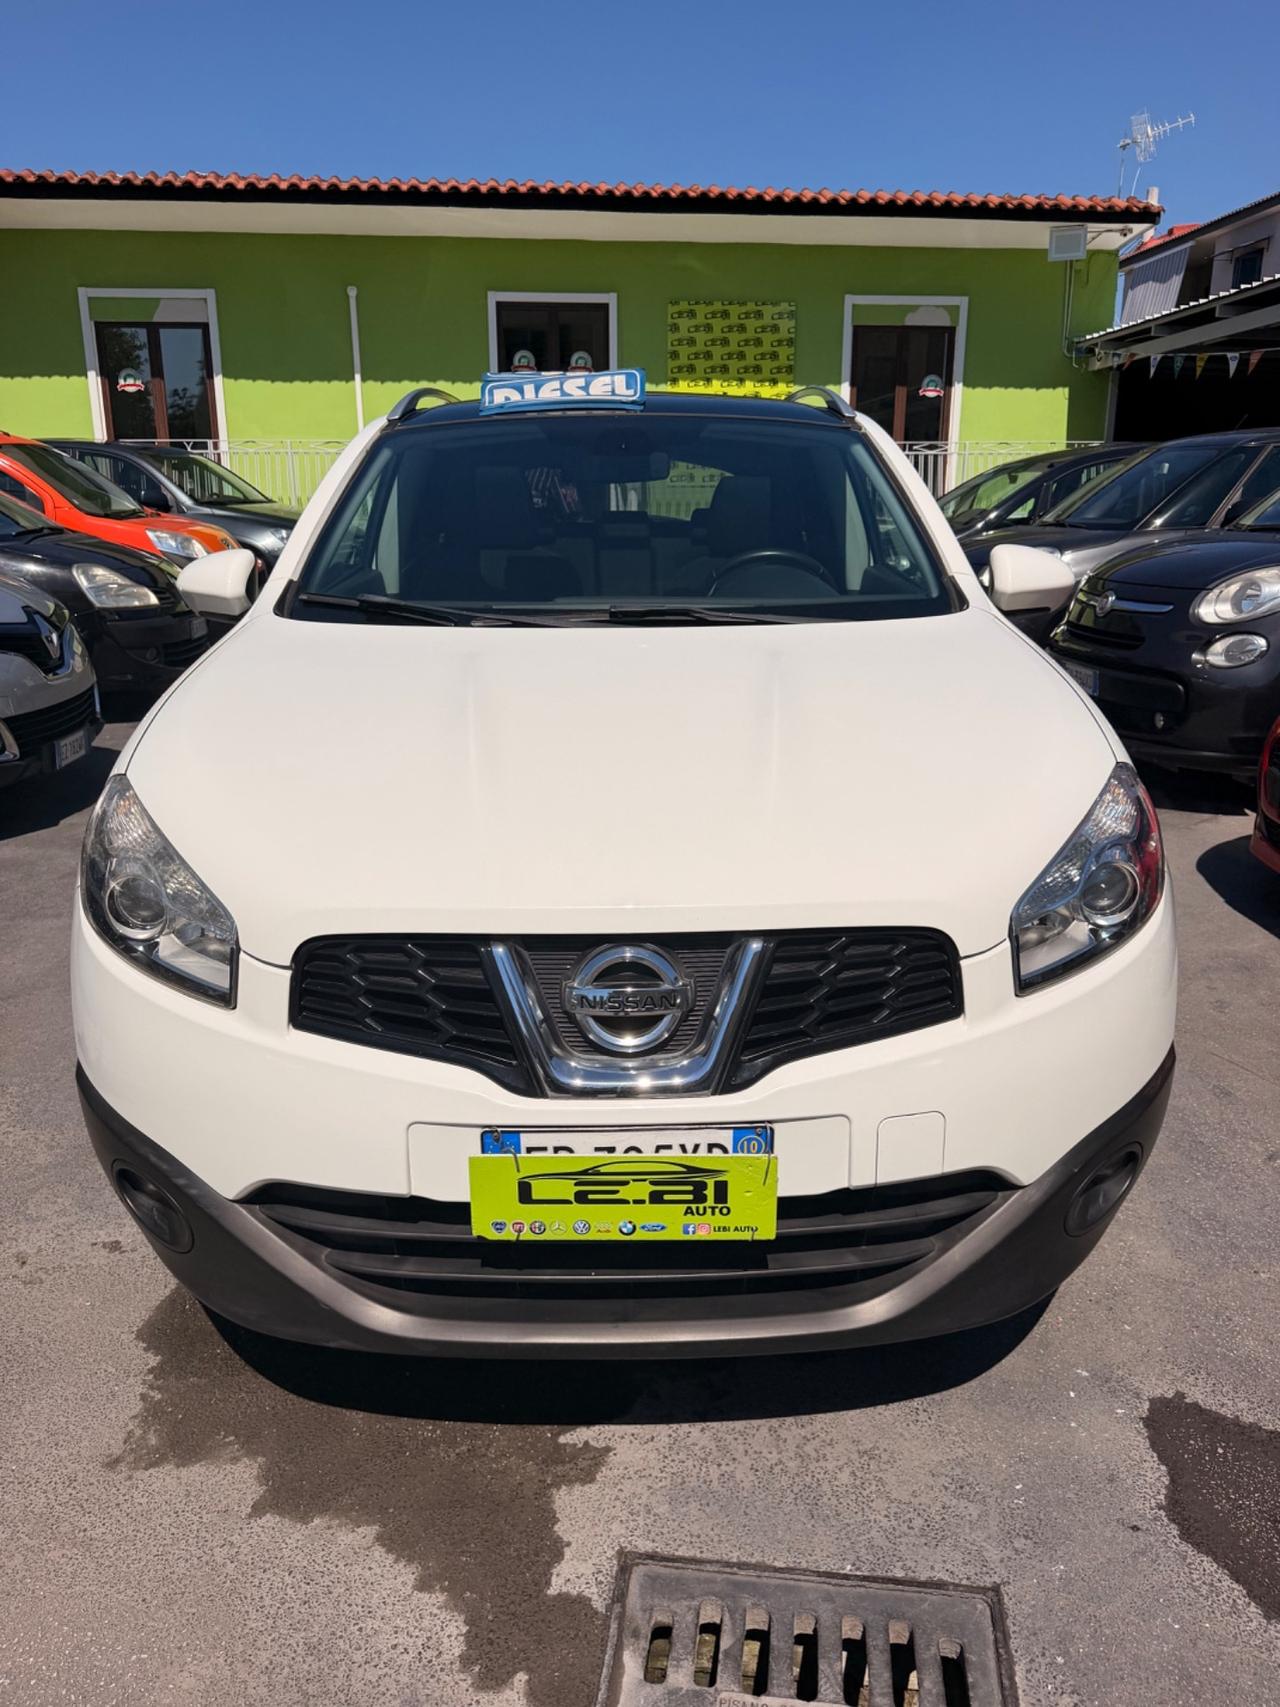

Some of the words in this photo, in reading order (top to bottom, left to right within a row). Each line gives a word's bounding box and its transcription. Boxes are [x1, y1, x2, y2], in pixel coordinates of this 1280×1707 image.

[493, 375, 635, 405] DIESEL
[580, 995, 677, 1011] NISSAN
[743, 1140, 758, 1154] 10
[683, 1206, 731, 1216] AUTO
